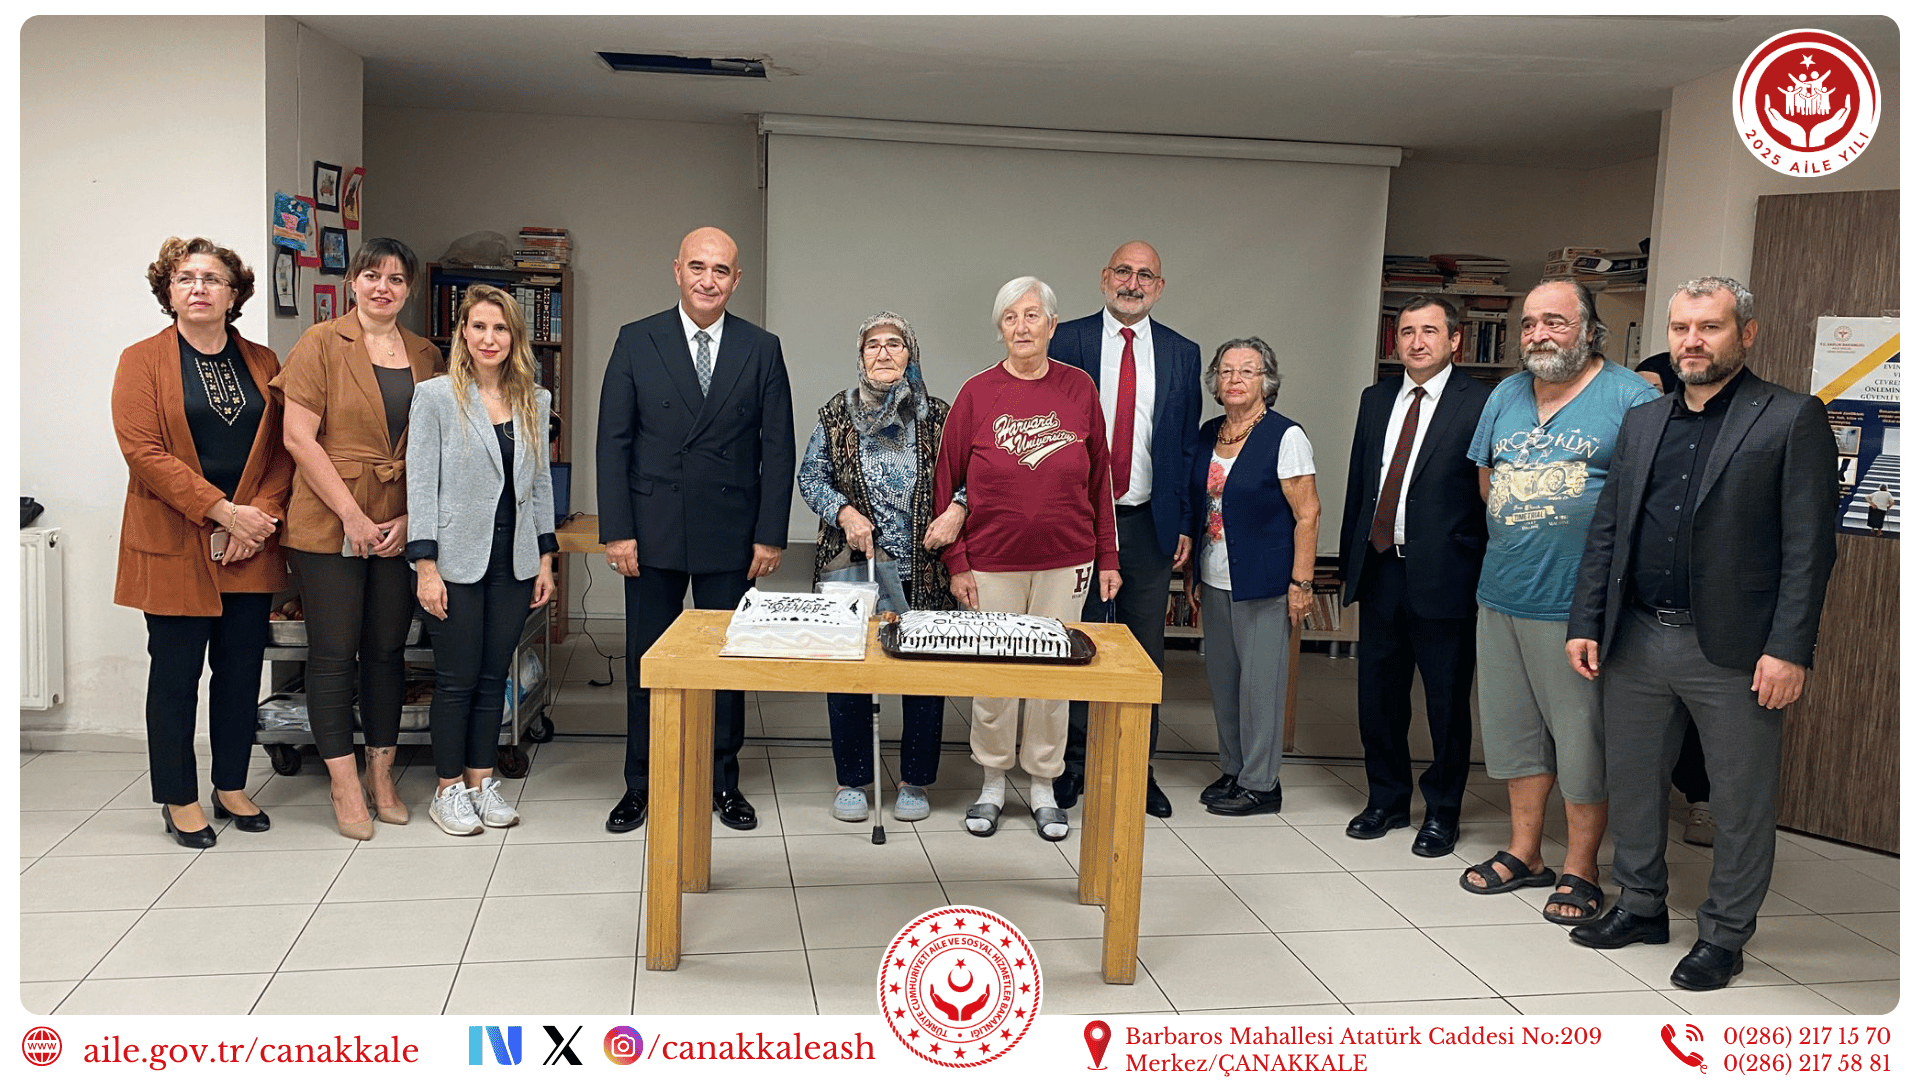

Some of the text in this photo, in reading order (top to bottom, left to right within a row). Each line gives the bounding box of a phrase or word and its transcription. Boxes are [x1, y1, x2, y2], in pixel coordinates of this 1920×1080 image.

[993, 411, 1060, 446] Harvard
[1014, 430, 1077, 456] University
[1074, 566, 1092, 593] H
